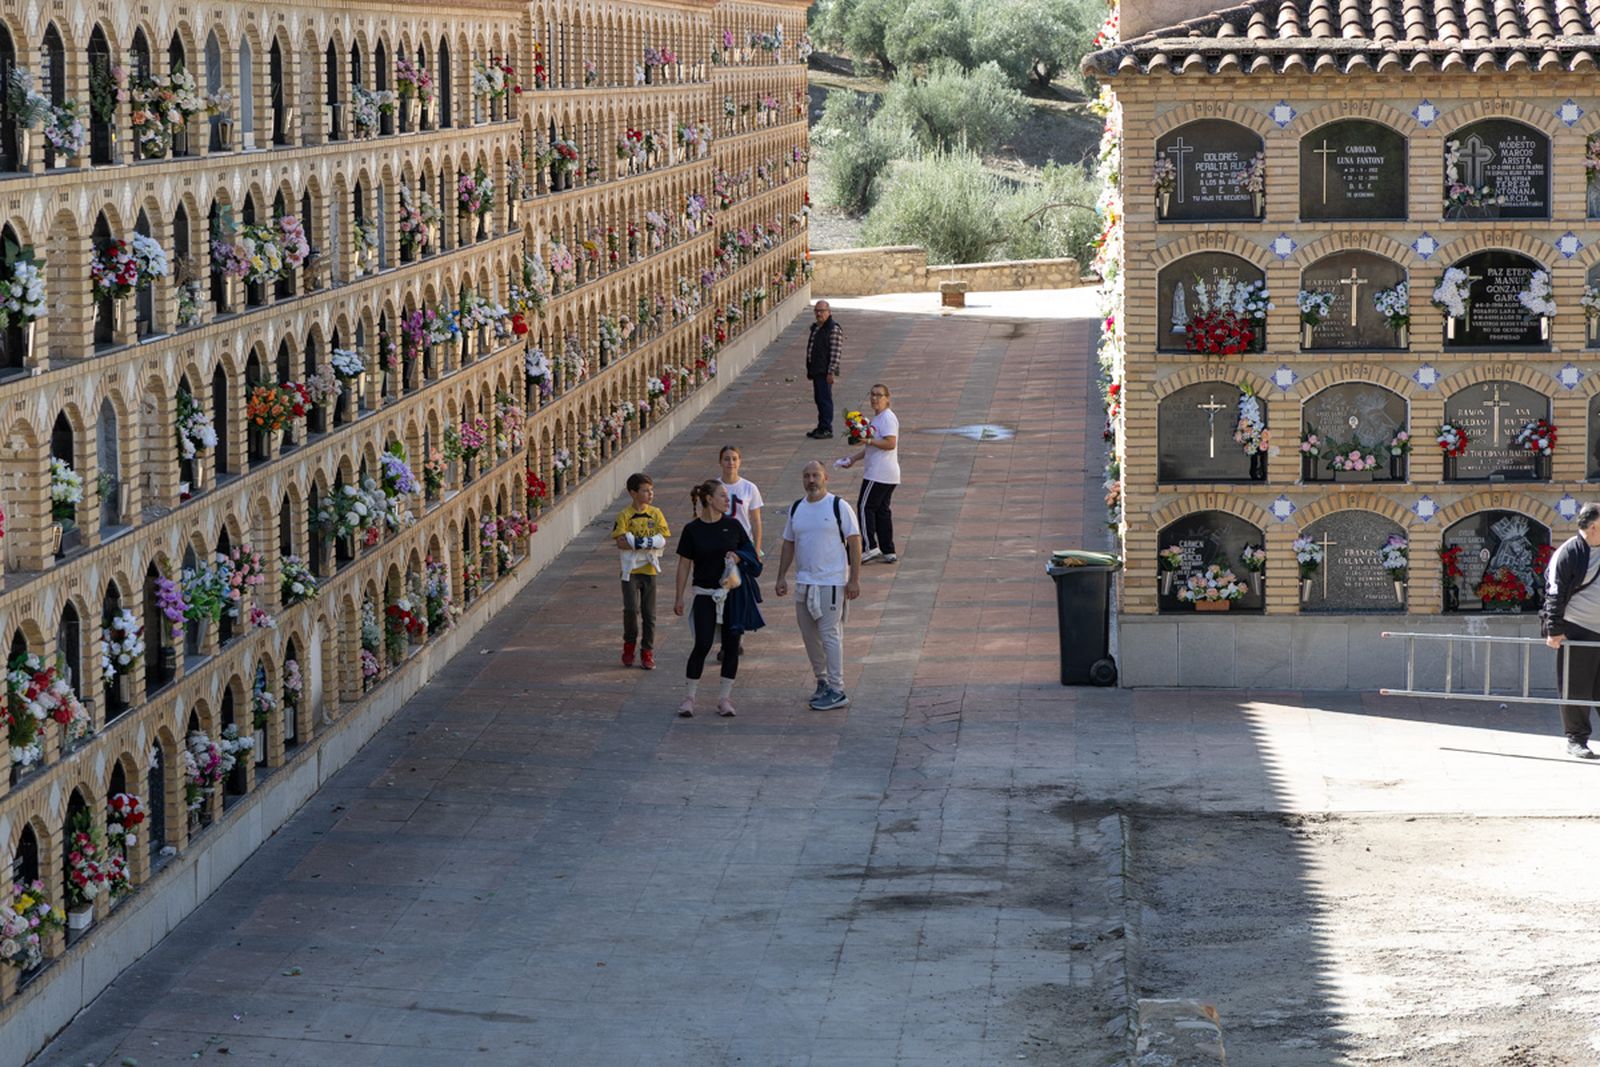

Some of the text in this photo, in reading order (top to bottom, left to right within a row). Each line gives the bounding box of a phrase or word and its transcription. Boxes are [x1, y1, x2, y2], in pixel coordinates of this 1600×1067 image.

[1197, 103, 1222, 112] 304
[1499, 141, 1535, 149] MODESTO
[1345, 146, 1376, 154] CAROLINA
[1501, 149, 1533, 157] MARCOS
[1204, 152, 1238, 162] DOLORES
[1196, 161, 1247, 171] PERALTA RUIZ
[1488, 268, 1504, 276] PAZ
[1458, 408, 1484, 416] RAMON
[1514, 408, 1530, 416] ANA
[1179, 540, 1204, 548] CARMEN
